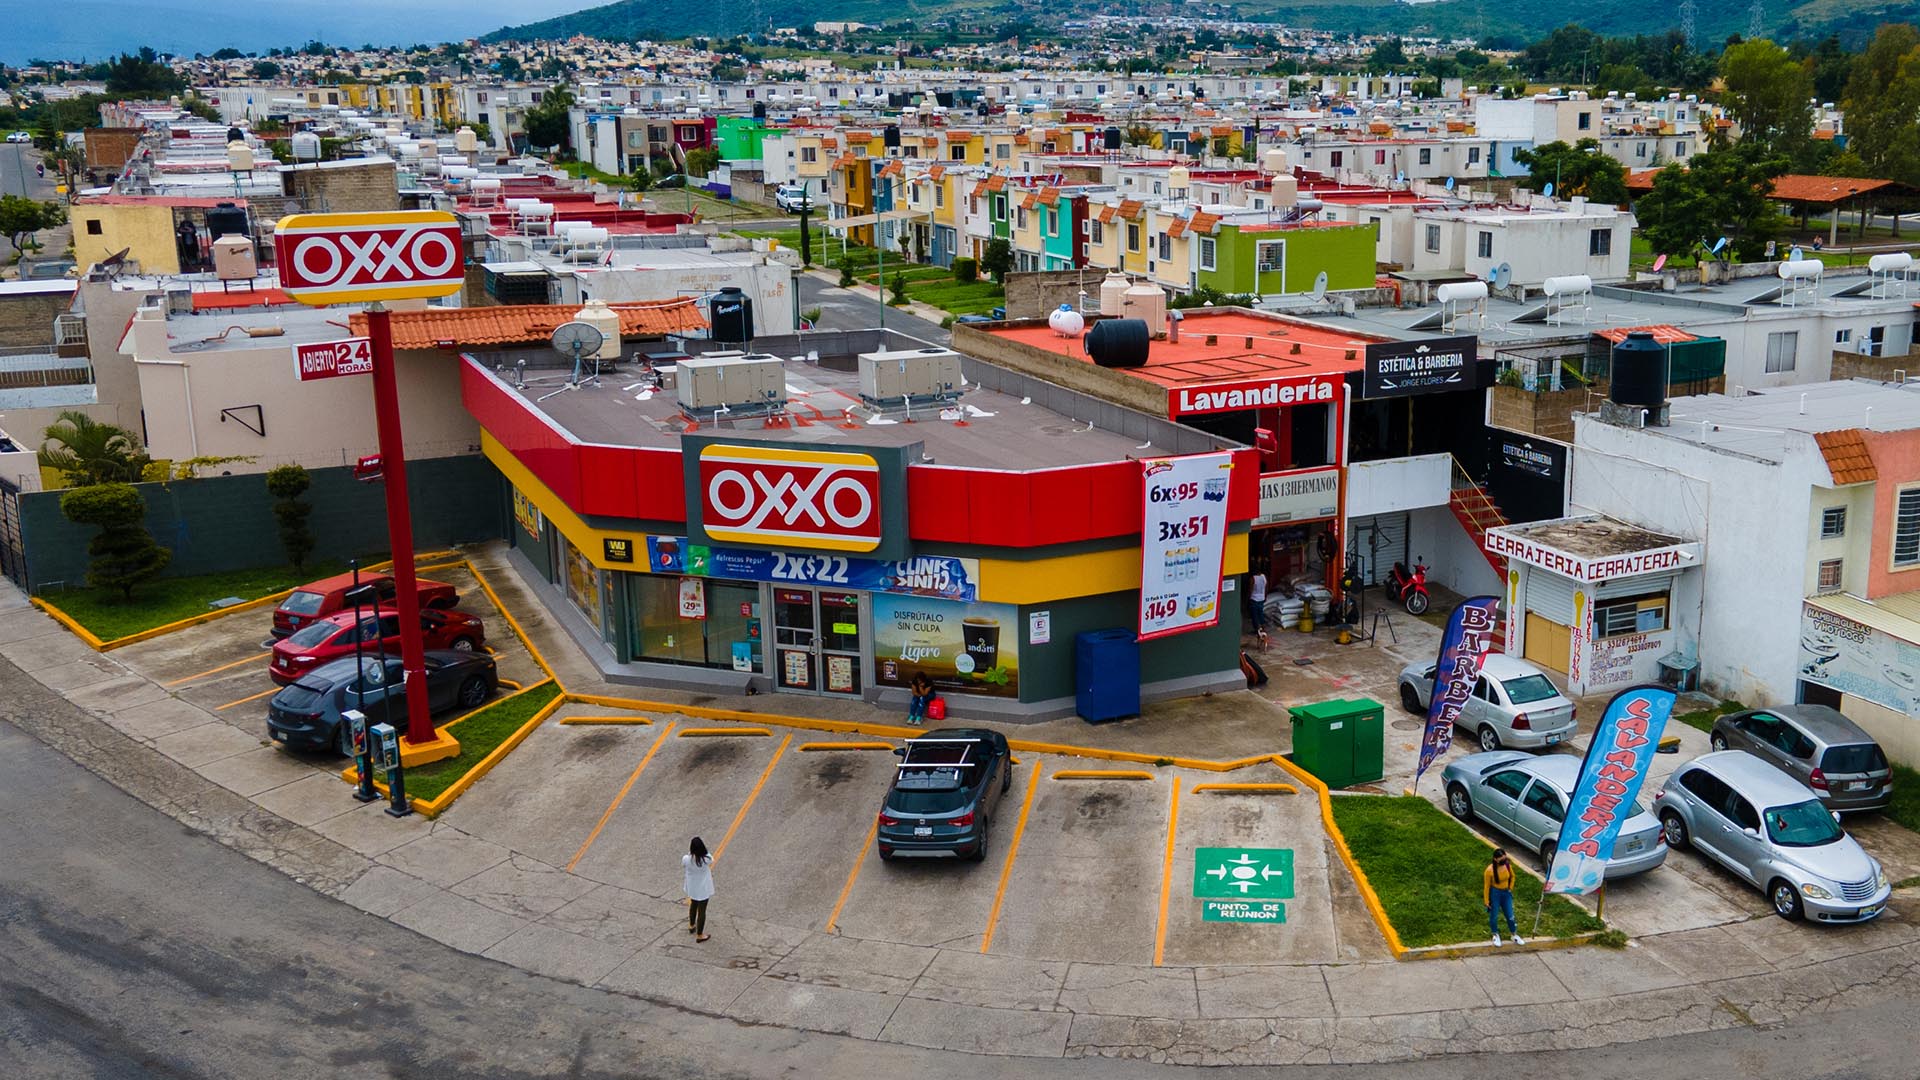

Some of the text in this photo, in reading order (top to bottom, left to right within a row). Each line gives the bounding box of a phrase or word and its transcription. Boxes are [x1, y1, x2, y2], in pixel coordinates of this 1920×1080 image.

[293, 229, 457, 286] OXXO
[302, 342, 371, 373] ABIERTO 24
[338, 362, 372, 374] HORAS
[1378, 352, 1464, 373] ESTÉTICA & BARBERIA
[1399, 376, 1445, 388] JORGE FLORES
[1180, 377, 1333, 412] Lavandería
[708, 468, 872, 529] OXXO
[1259, 480, 1279, 500] ÍAS
[896, 558, 951, 577] CLINK
[1486, 533, 1584, 579] CERRAJERIA
[1587, 550, 1680, 581] CERRAJERIA
[894, 610, 944, 623] DISFRÚTALO
[1144, 598, 1177, 621] $149
[1585, 596, 1593, 644] LLAVES
[897, 622, 941, 633] SIN CULPA
[1806, 607, 1872, 636] HAMBURGUESAS
[1813, 619, 1865, 644] Y HOT DOGS
[899, 639, 941, 664] Ligero
[967, 644, 995, 654] andatti
[1591, 640, 1604, 652] TEL
[1568, 697, 1652, 858] LAVANDERIA
[1208, 902, 1280, 912] PUNTO DE
[1219, 910, 1277, 919] REUNION
